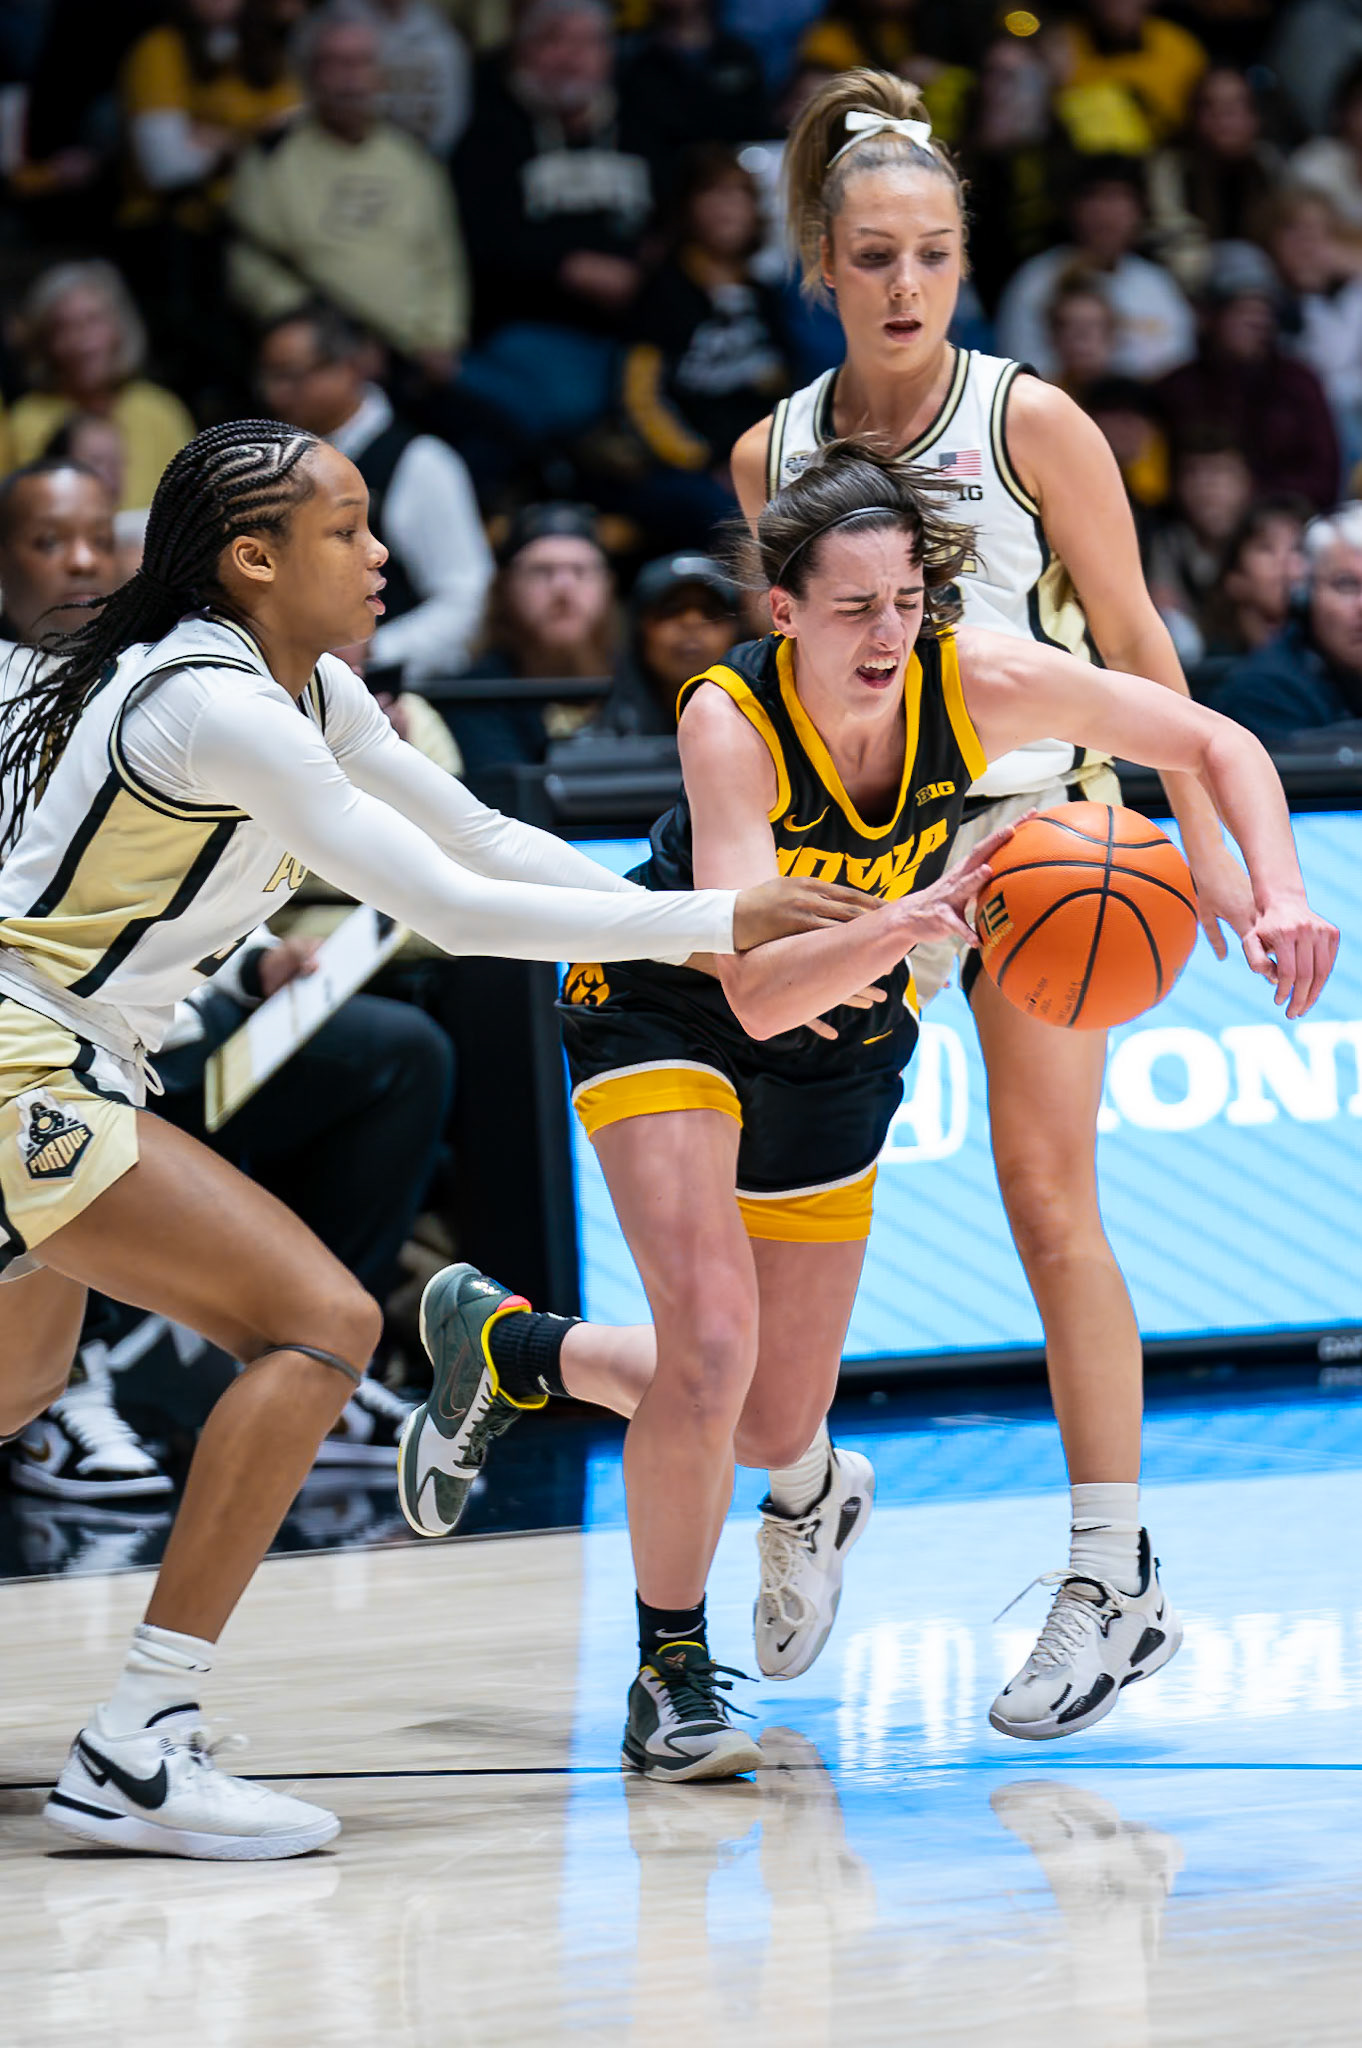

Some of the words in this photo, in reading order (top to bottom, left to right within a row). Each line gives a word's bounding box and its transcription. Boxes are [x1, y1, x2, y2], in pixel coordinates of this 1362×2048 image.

[776, 818, 949, 891] IOWA
[1096, 1020, 1362, 1133] ON
[29, 1127, 90, 1174] PURDUE
